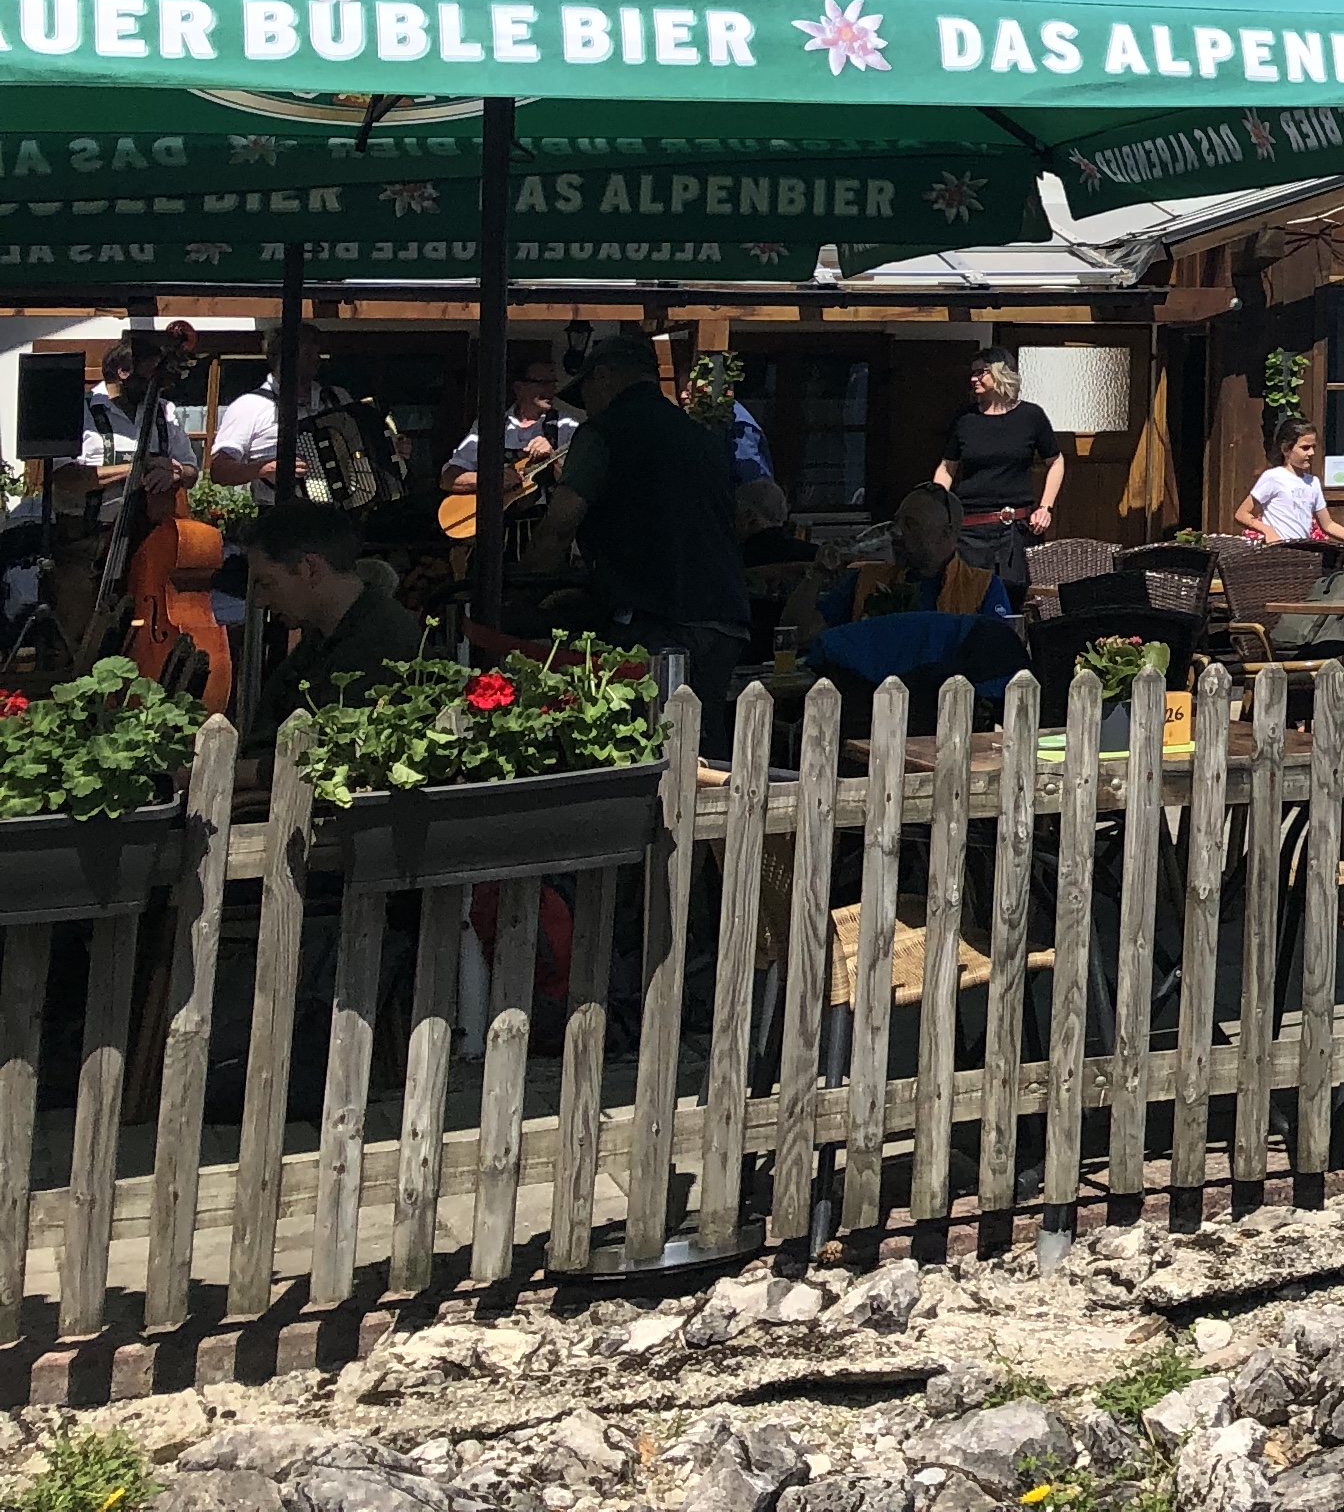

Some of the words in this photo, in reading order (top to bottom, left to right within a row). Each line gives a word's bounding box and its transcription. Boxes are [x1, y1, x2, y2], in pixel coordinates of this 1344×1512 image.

[561, 4, 757, 67] BIER
[937, 16, 1085, 73] DAS
[479, 173, 584, 215] AS
[599, 174, 896, 218] ALPENBIER
[1165, 705, 1184, 723] 26
